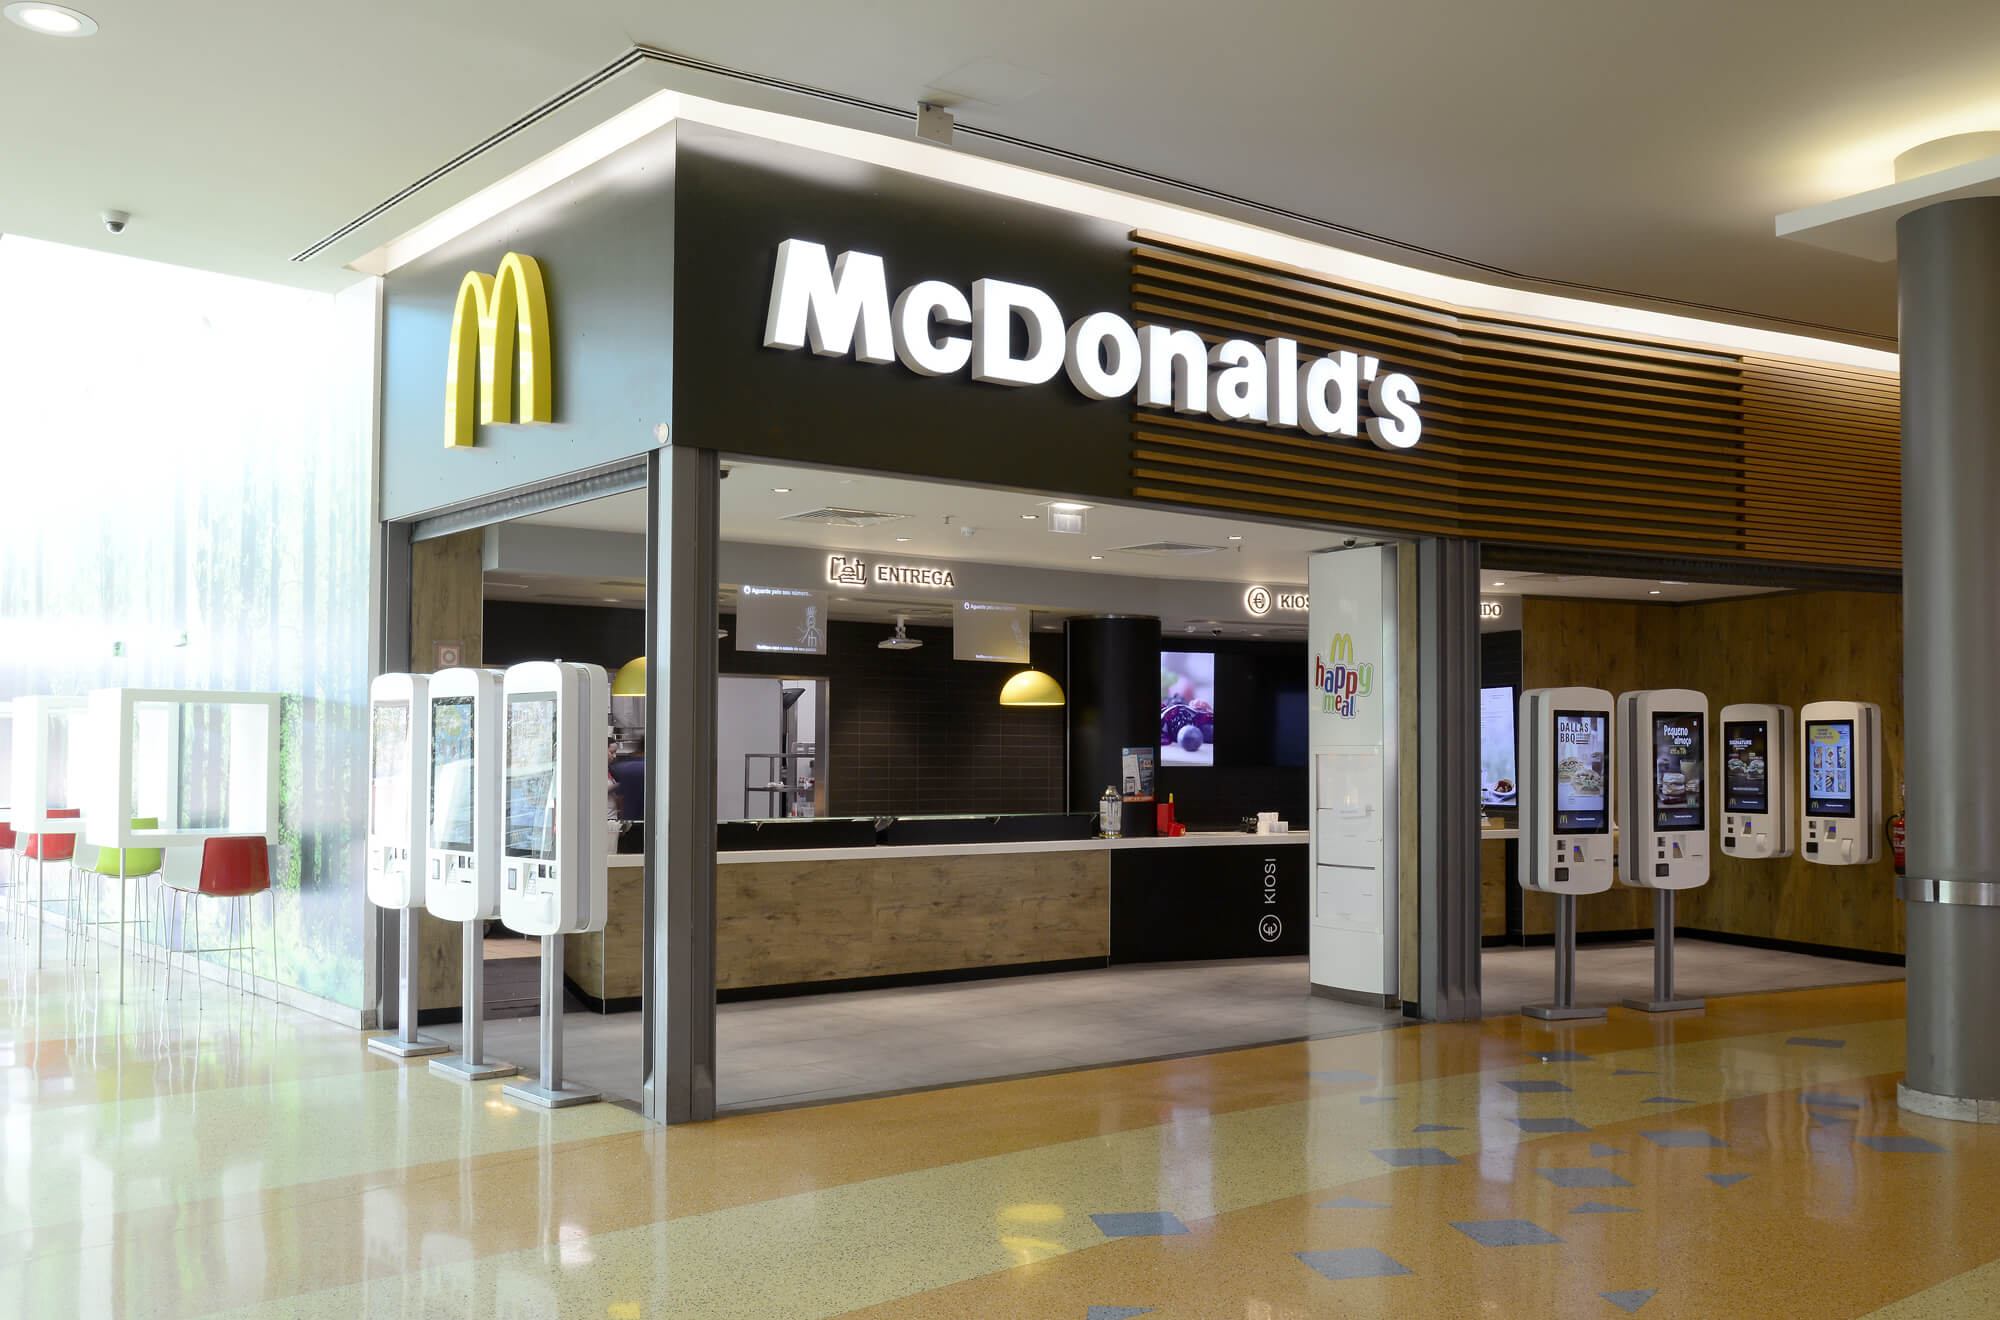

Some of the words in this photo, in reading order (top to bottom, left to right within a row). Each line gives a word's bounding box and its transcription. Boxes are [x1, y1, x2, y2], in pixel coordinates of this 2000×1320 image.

[763, 238, 1422, 451] McDonald's
[878, 566, 955, 587] ENTREGA
[1315, 655, 1373, 699] happy
[1323, 694, 1356, 717] meal
[1560, 722, 1589, 733] DALLAS
[1663, 725, 1689, 738] Pequeno
[1560, 733, 1576, 744] BBQ
